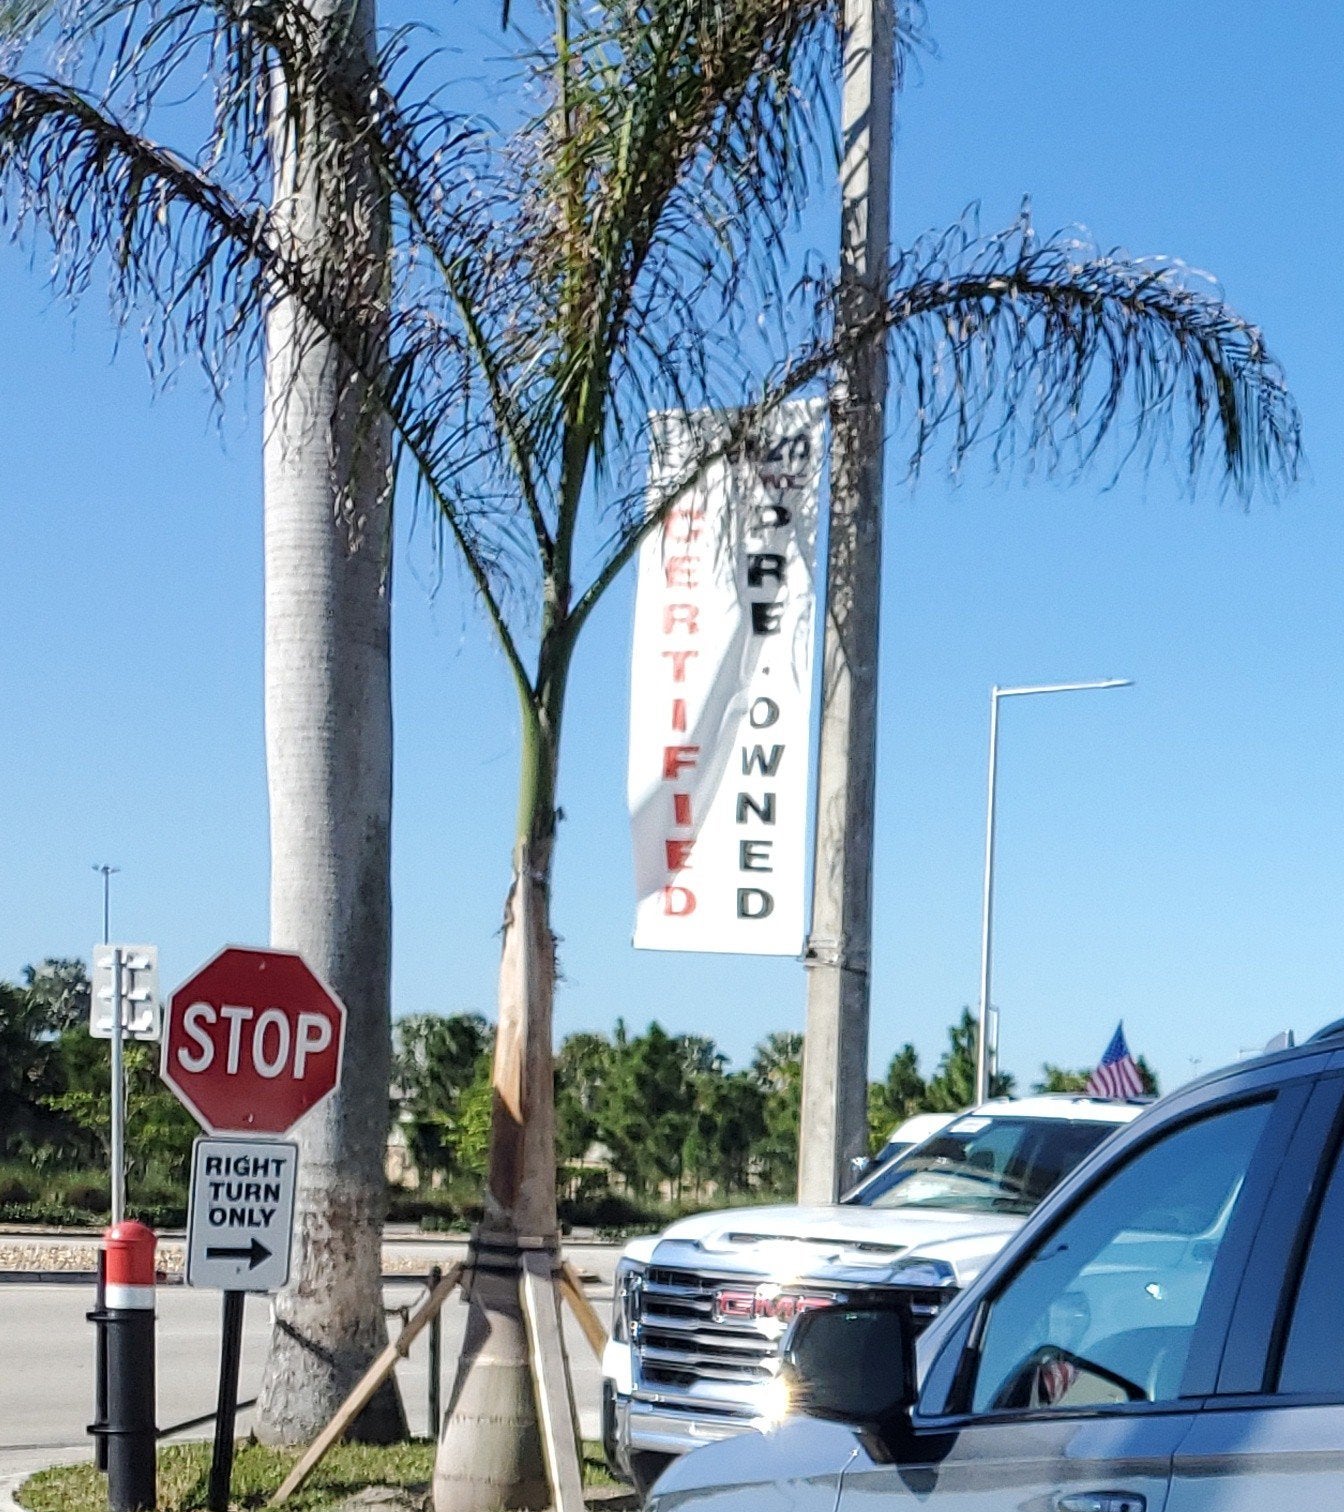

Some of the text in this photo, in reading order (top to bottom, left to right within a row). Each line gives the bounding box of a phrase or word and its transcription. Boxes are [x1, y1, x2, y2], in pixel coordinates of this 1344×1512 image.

[662, 508, 704, 917] CERTIFIED
[177, 1001, 332, 1080] STOP
[205, 1155, 287, 1178] RIGHT
[209, 1181, 281, 1203] TURN
[208, 1207, 276, 1228] ONLY
